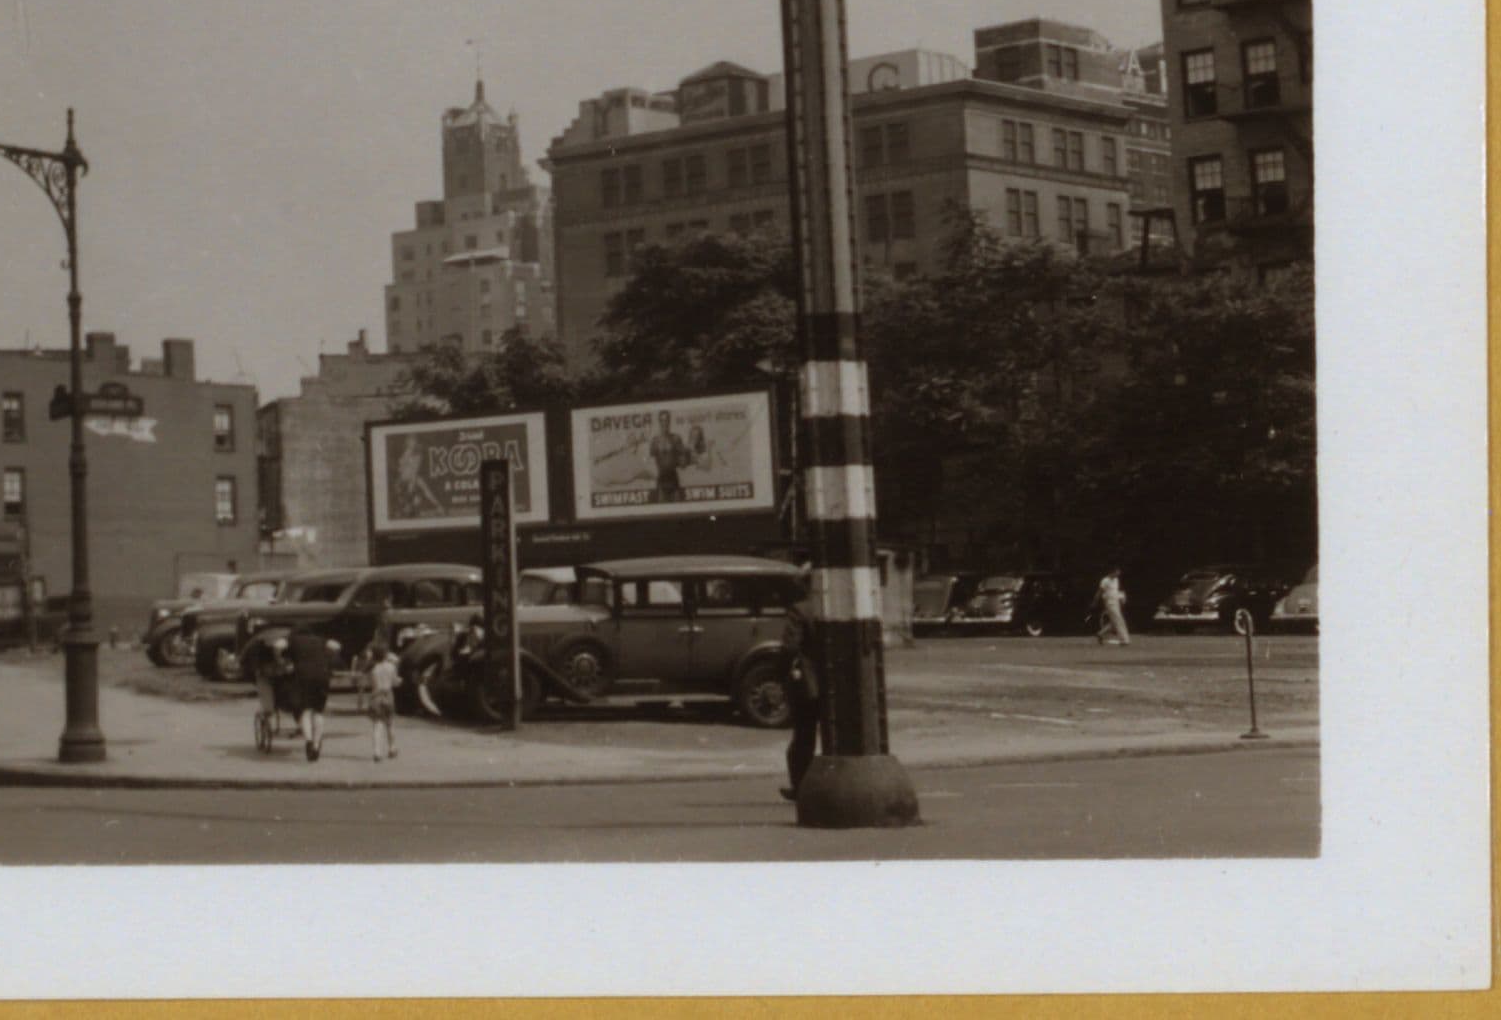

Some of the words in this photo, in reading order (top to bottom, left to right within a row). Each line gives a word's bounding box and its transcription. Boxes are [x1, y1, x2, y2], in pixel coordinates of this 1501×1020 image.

[591, 411, 652, 433] DAVEGA
[685, 486, 716, 501] SWIM
[718, 483, 749, 499] SUITS
[488, 469, 509, 637] PARKING
